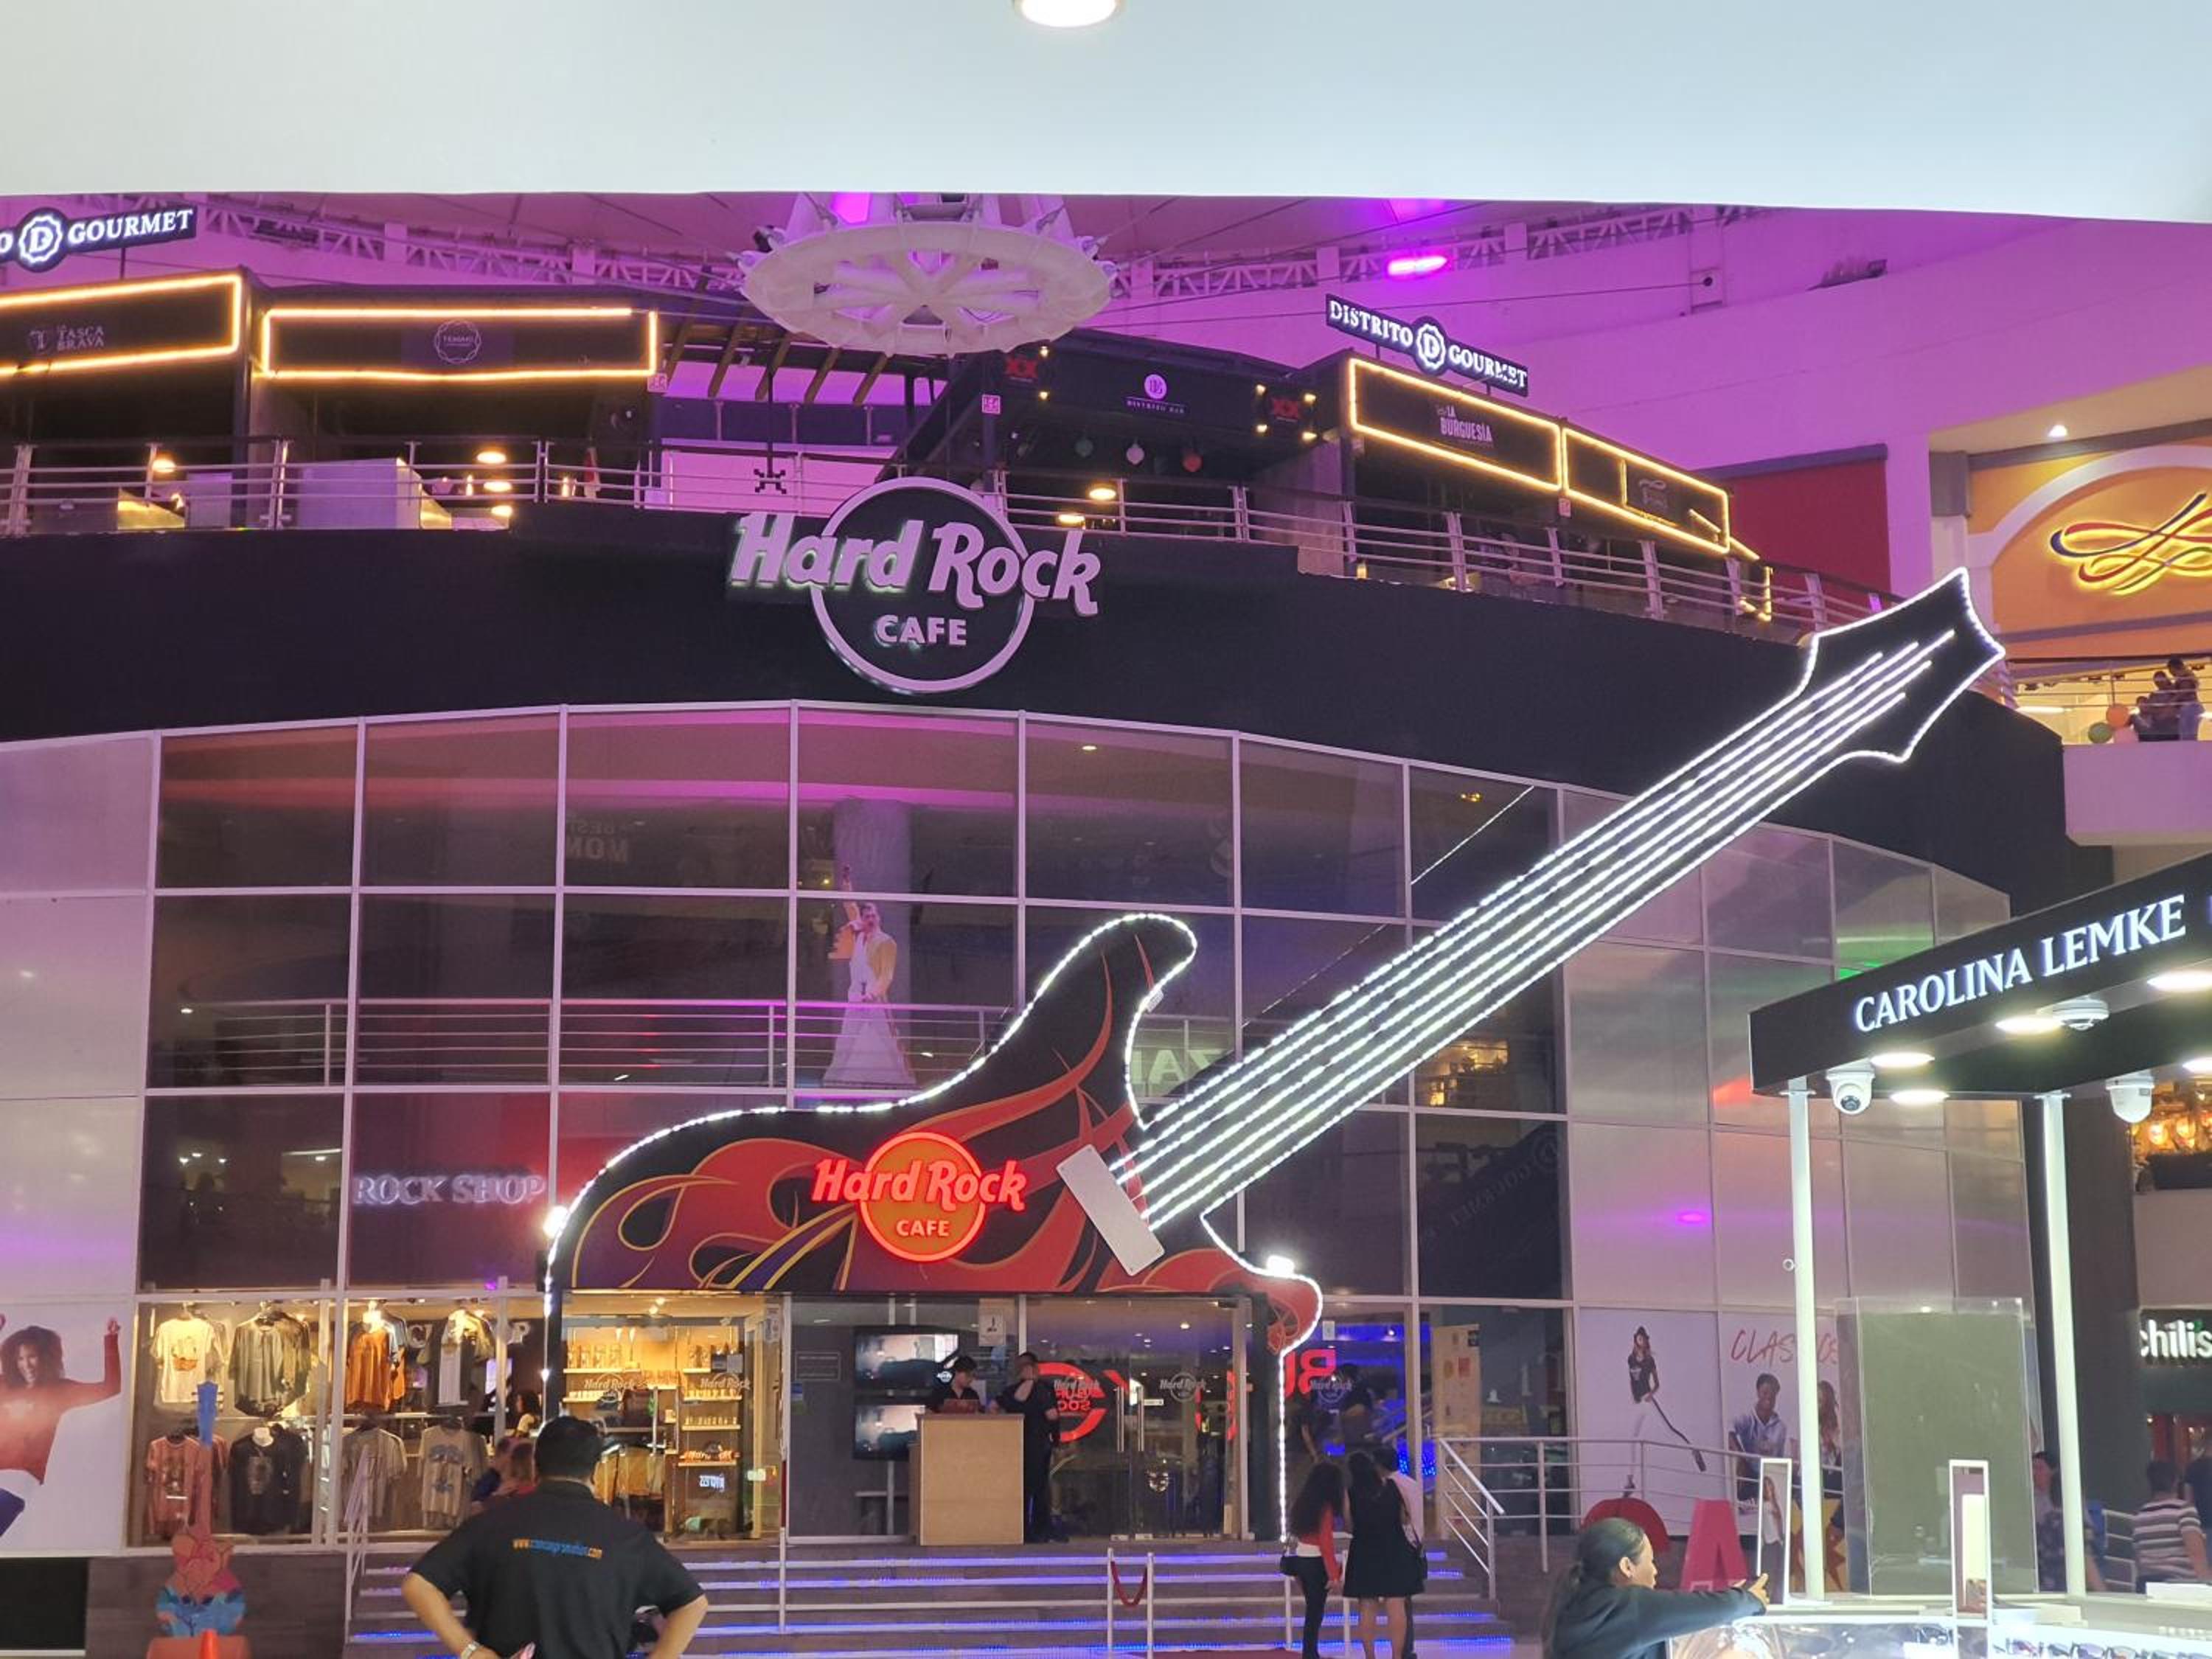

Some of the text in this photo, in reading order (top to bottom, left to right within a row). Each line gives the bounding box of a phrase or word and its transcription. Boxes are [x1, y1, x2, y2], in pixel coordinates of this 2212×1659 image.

[67, 209, 193, 245] GOURMET
[1330, 299, 1413, 347] DISTRITO
[1449, 344, 1527, 388] GOURMET
[1447, 405, 1456, 418] LA
[730, 512, 1101, 616] Hard Rock
[875, 614, 967, 647] CAFE
[1854, 894, 2186, 1032] CAROLINA LEMKE
[353, 1173, 546, 1205] ROCK SHOP
[812, 1158, 1027, 1212] Hard Rock
[897, 1220, 950, 1237] CAFE
